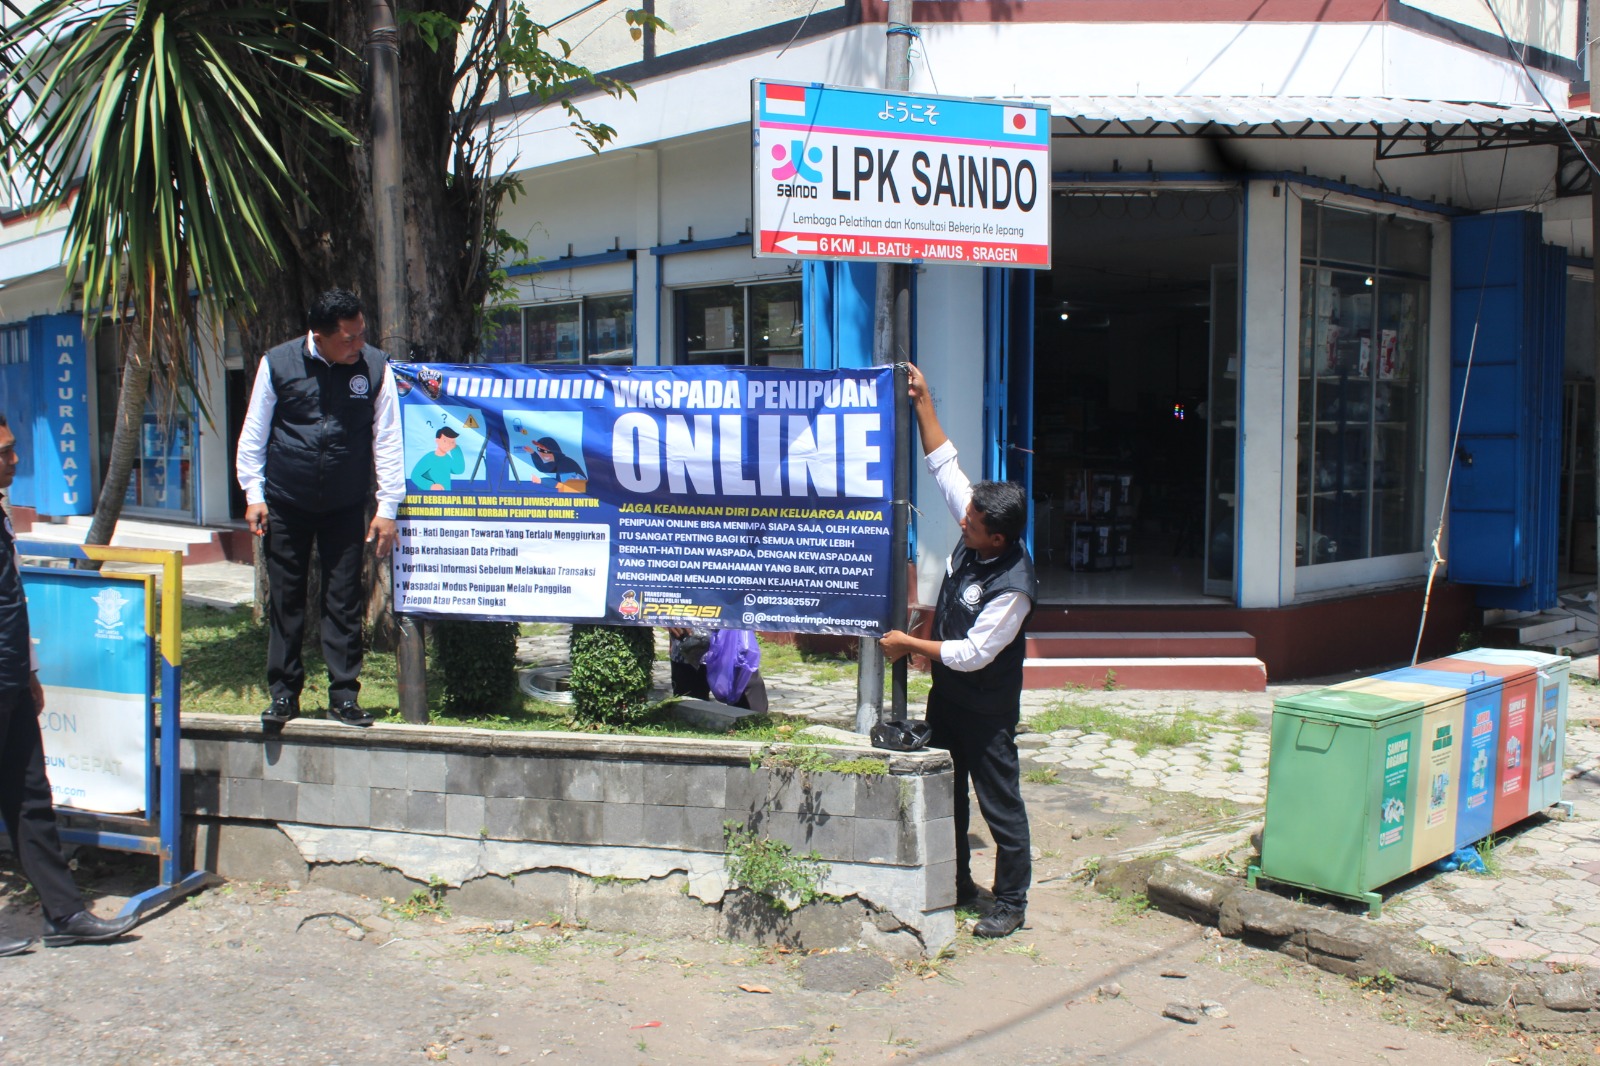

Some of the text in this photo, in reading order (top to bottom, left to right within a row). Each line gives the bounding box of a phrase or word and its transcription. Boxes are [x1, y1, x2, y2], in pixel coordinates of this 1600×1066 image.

[878, 100, 940, 125] ようこそ
[832, 145, 1037, 213] LPK SAINDO
[793, 212, 1024, 237] Lembaga Pelatihan dan Konsultasi Bekerja Ke Jepang
[819, 237, 829, 252] 6
[831, 238, 855, 253] KM
[859, 241, 911, 257] JL.BATU
[921, 244, 963, 259] JAMUS
[972, 246, 1018, 261] SRAGEN
[611, 378, 877, 409] WASPADA PENIPUAN
[612, 412, 883, 497] ONLINE
[404, 495, 599, 507] IKUT BEBERAPA HAL YANG PERLU DIWASPADAI UNTUK
[398, 506, 442, 516] ENGHINDARI
[444, 507, 476, 516] MENJADI
[477, 508, 508, 517] KORBAN
[510, 509, 546, 518] PENIPUAN
[548, 510, 575, 519] ONLINE
[619, 503, 883, 521] JAGA KEAMANAN DIRI DAN KELUARGA ANDA
[402, 527, 417, 537] Hati
[423, 527, 438, 537] Hati
[440, 528, 469, 538] Dengan
[471, 528, 503, 538] Tawaran
[505, 529, 524, 539] Yang
[526, 530, 552, 539] Terlalu
[554, 530, 605, 541] Menggiurkan
[619, 518, 890, 535] PENIPUAN ONLINE BISA MENIMPA SIAPA SAJA, OLEH KARENA
[619, 532, 855, 548] ITU SANGAT PENTING BAGI KITA SEMUA UNTUK LEBIH
[402, 545, 518, 556] Jaga Kerahasiaan Data Pribadi
[619, 545, 872, 563] BERHATI-HATI DAN WASPADA, DENGAN KEWASPADAAN
[402, 563, 596, 576] Verifikasi Informasi Sebelum Melakukan Transaksi
[618, 558, 874, 577] YANG TINGGI DAN PEMAHAMAN YANG BAIK, KITA DAPAT
[402, 581, 571, 594] Waspadai Modus Penipuan Melalu Panggilan
[617, 571, 859, 590] MENGHINDARI MENJADI KORBAN KEJAHATAN ONLINE
[402, 595, 506, 607] Telepon Atau Pesan Singkat
[644, 591, 681, 599] TRANSFORMASI
[757, 596, 820, 607] 081233625577
[643, 603, 722, 618] PRESISI
[754, 612, 879, 629] @satreskrimpolressragen
[50, 785, 86, 797] an.com
